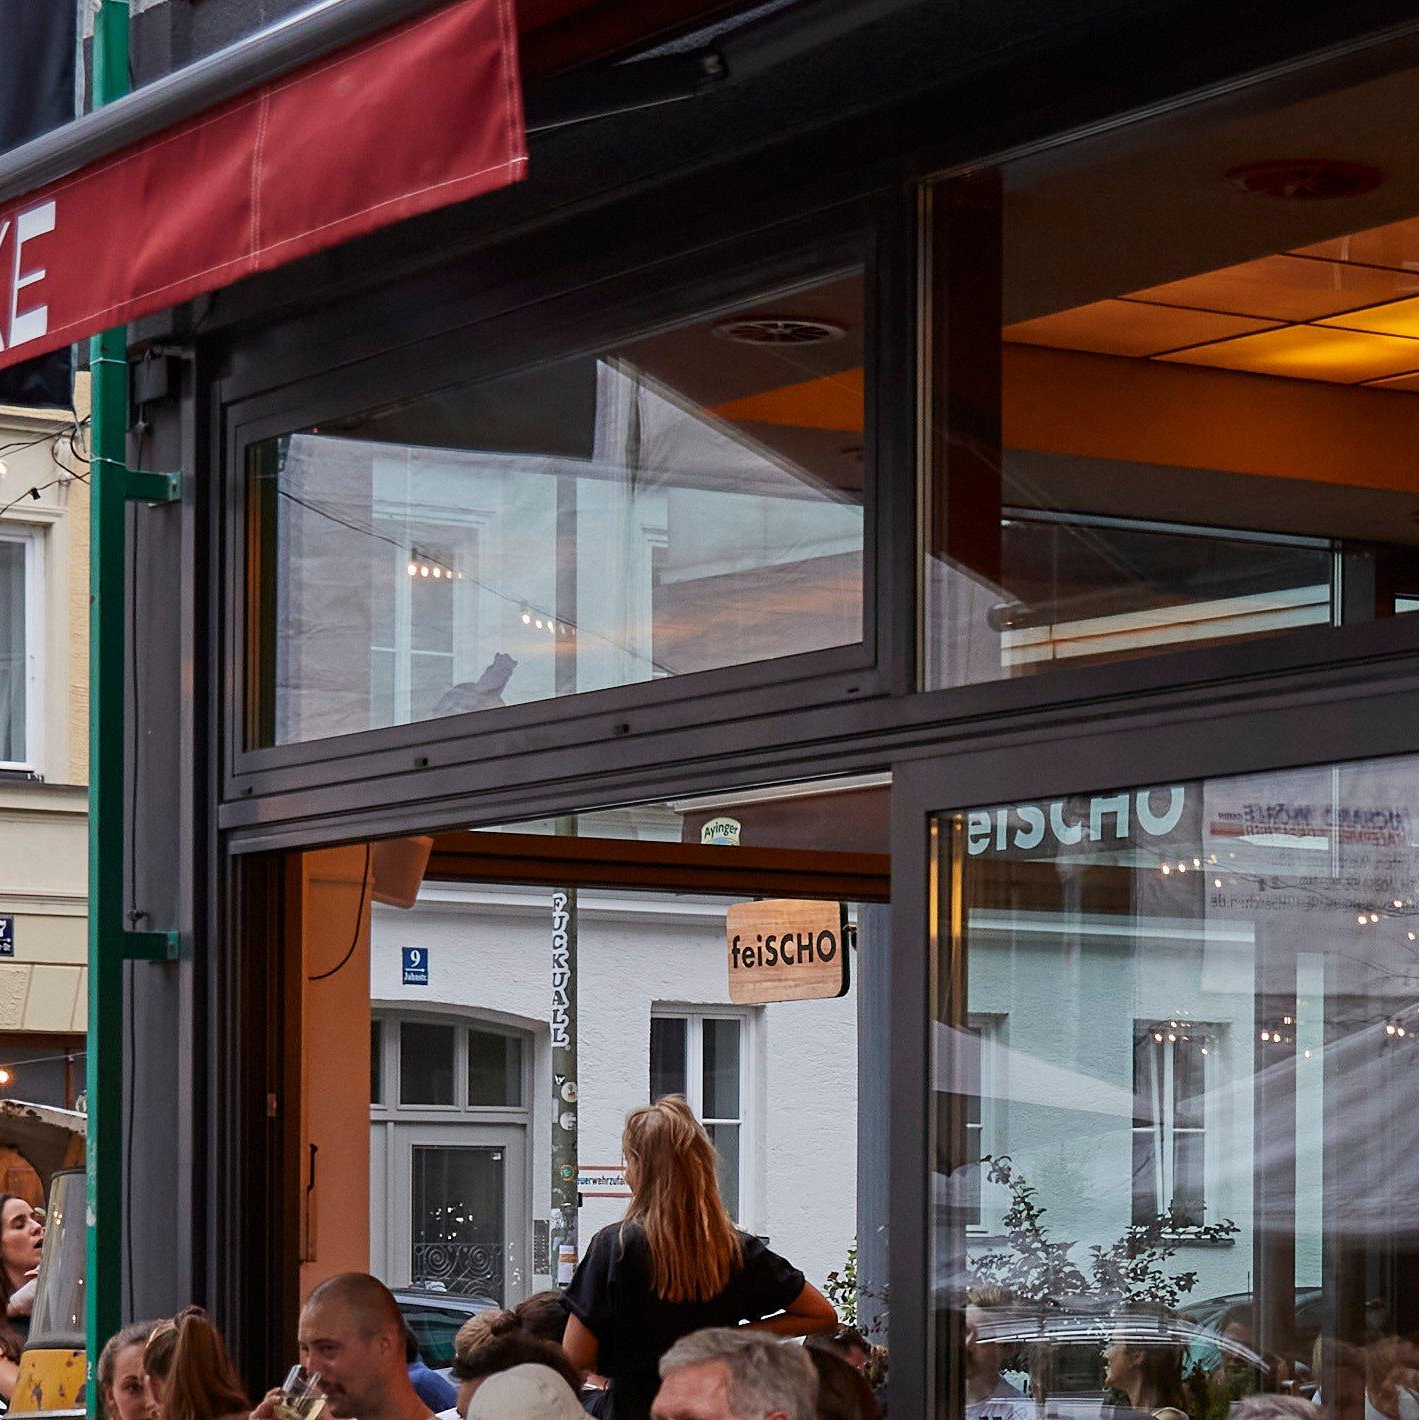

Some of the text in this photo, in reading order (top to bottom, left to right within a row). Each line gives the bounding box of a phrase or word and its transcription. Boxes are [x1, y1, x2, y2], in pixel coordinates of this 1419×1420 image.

[704, 821, 738, 839] Ayinger
[410, 949, 421, 968] 9
[731, 929, 837, 969] feiSCHO
